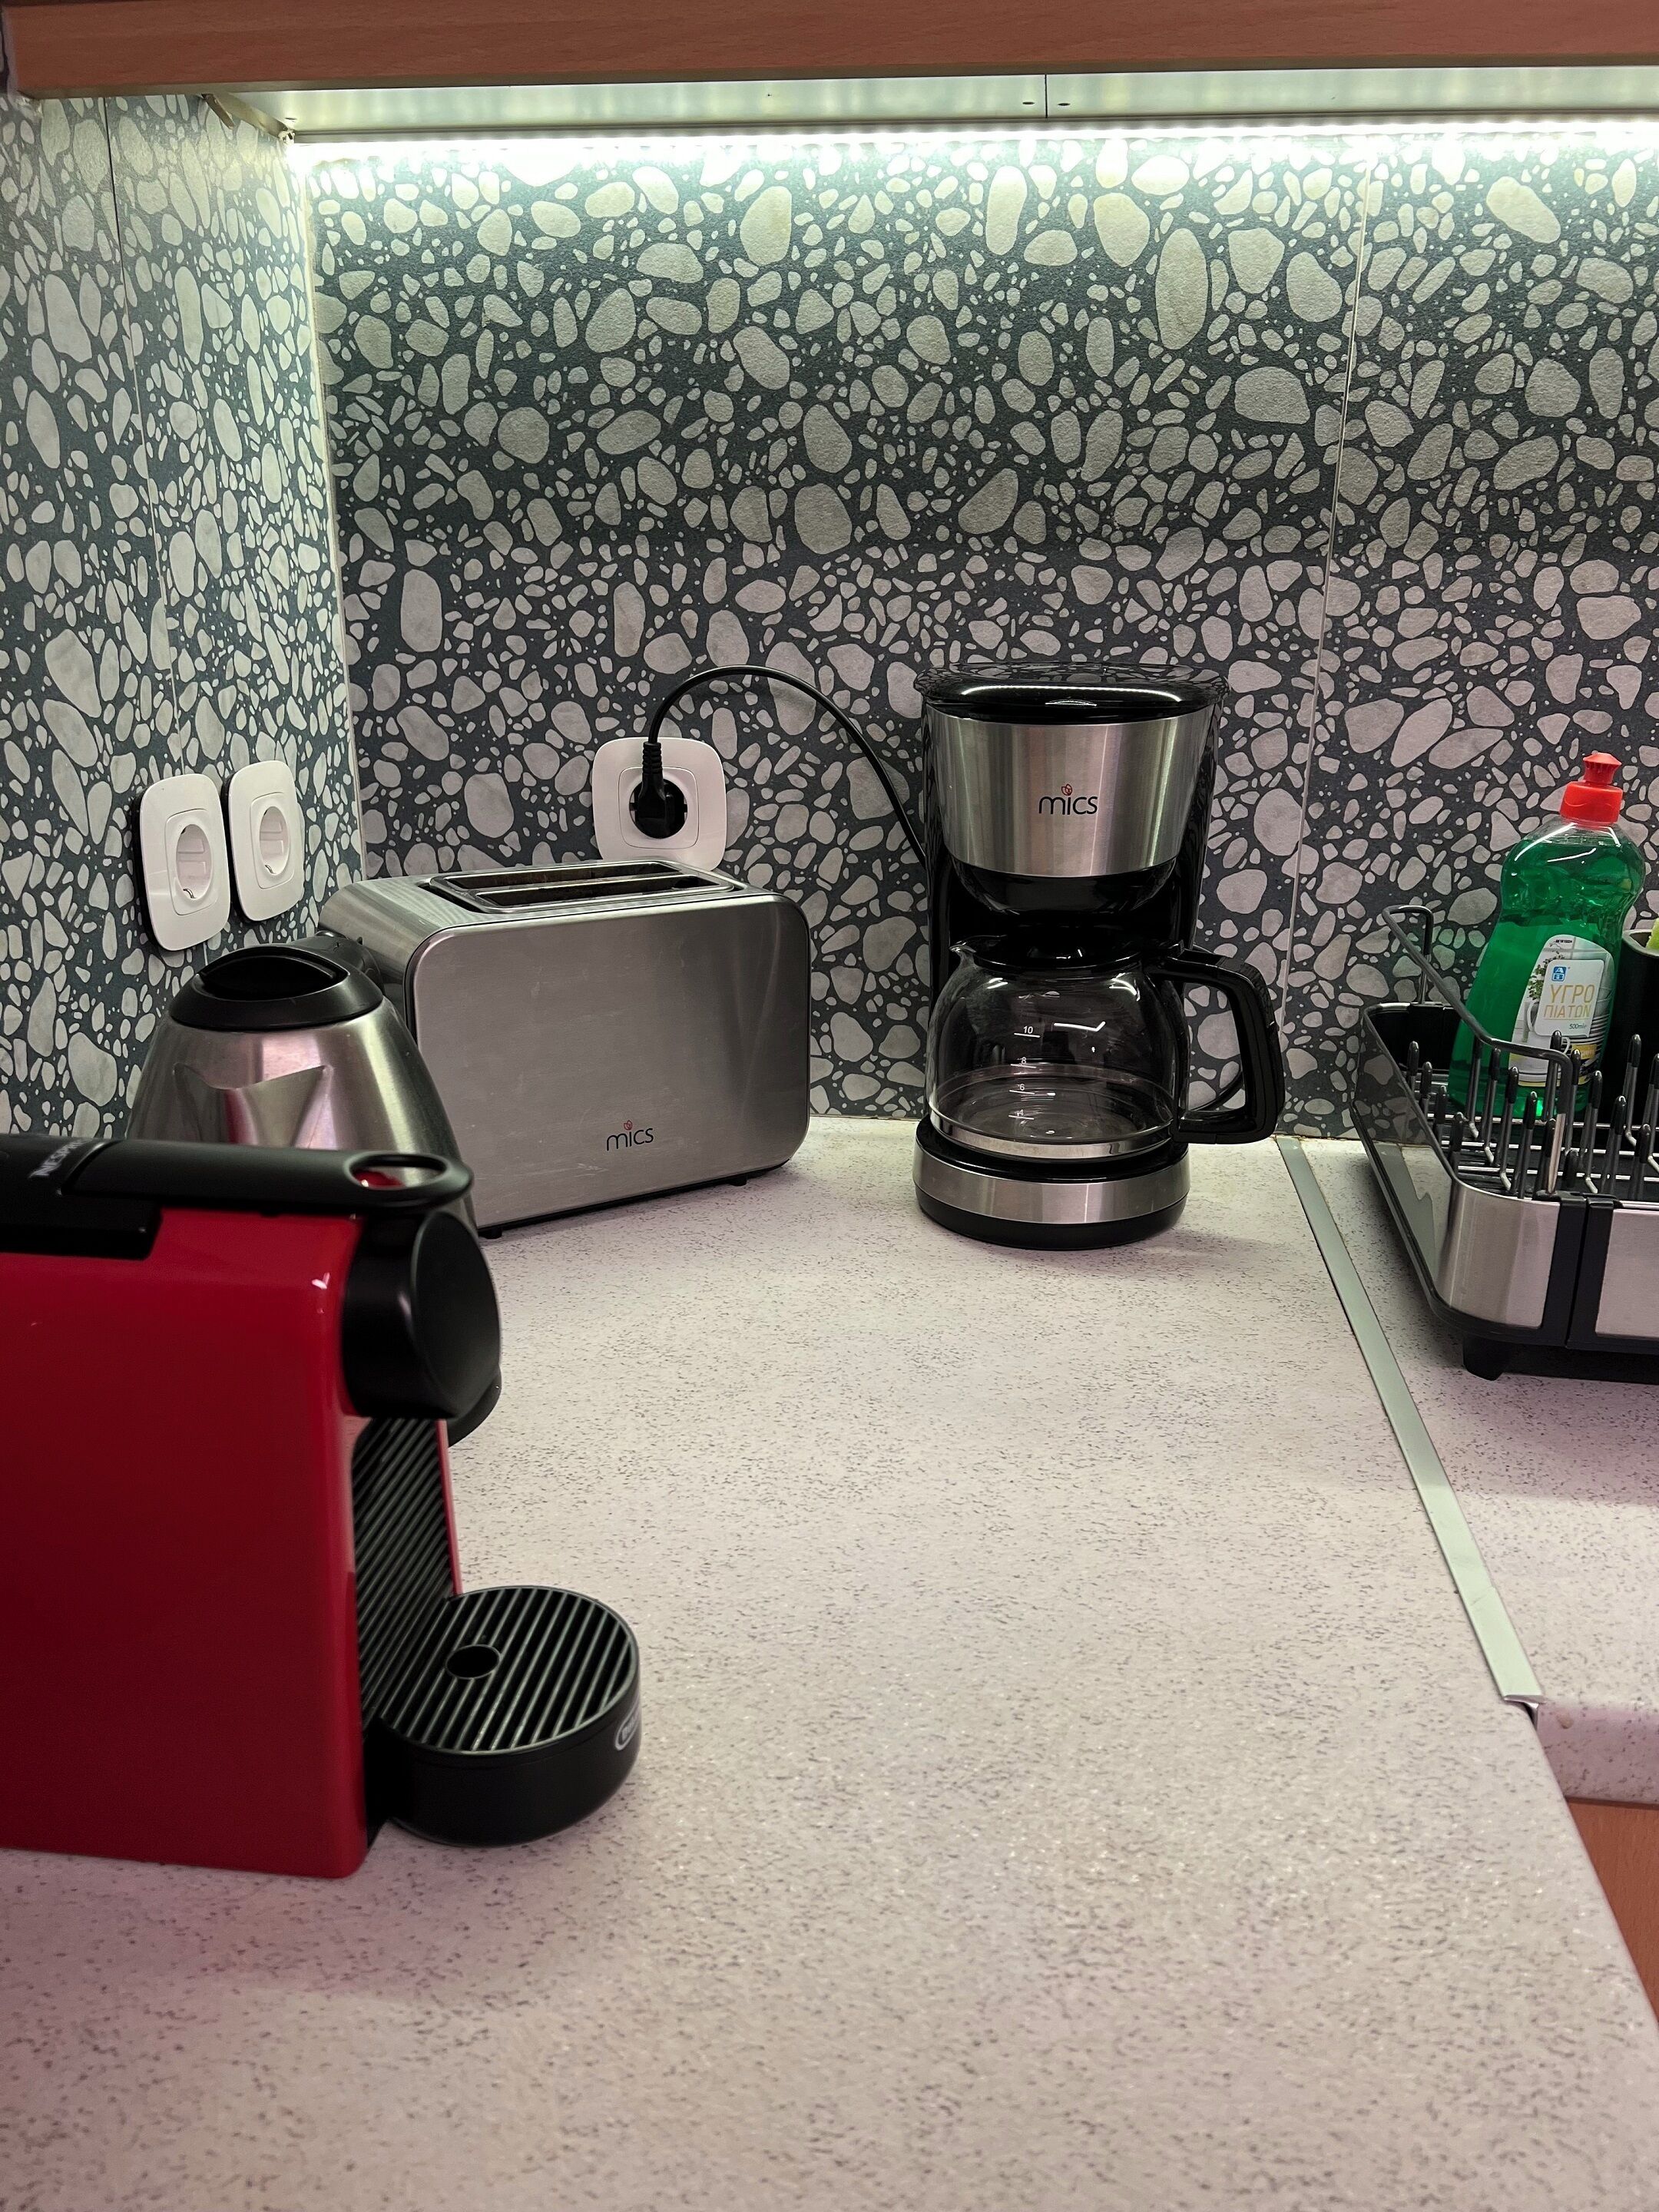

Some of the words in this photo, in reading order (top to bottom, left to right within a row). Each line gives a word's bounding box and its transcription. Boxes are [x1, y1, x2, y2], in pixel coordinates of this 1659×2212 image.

[1038, 783, 1098, 815] mics
[1551, 985, 1594, 1003] ΥΓΡΟ
[1544, 1005, 1591, 1018] ΠΙΑΤΩΝ
[1024, 1025, 1034, 1034] 10
[606, 1120, 654, 1151] mics
